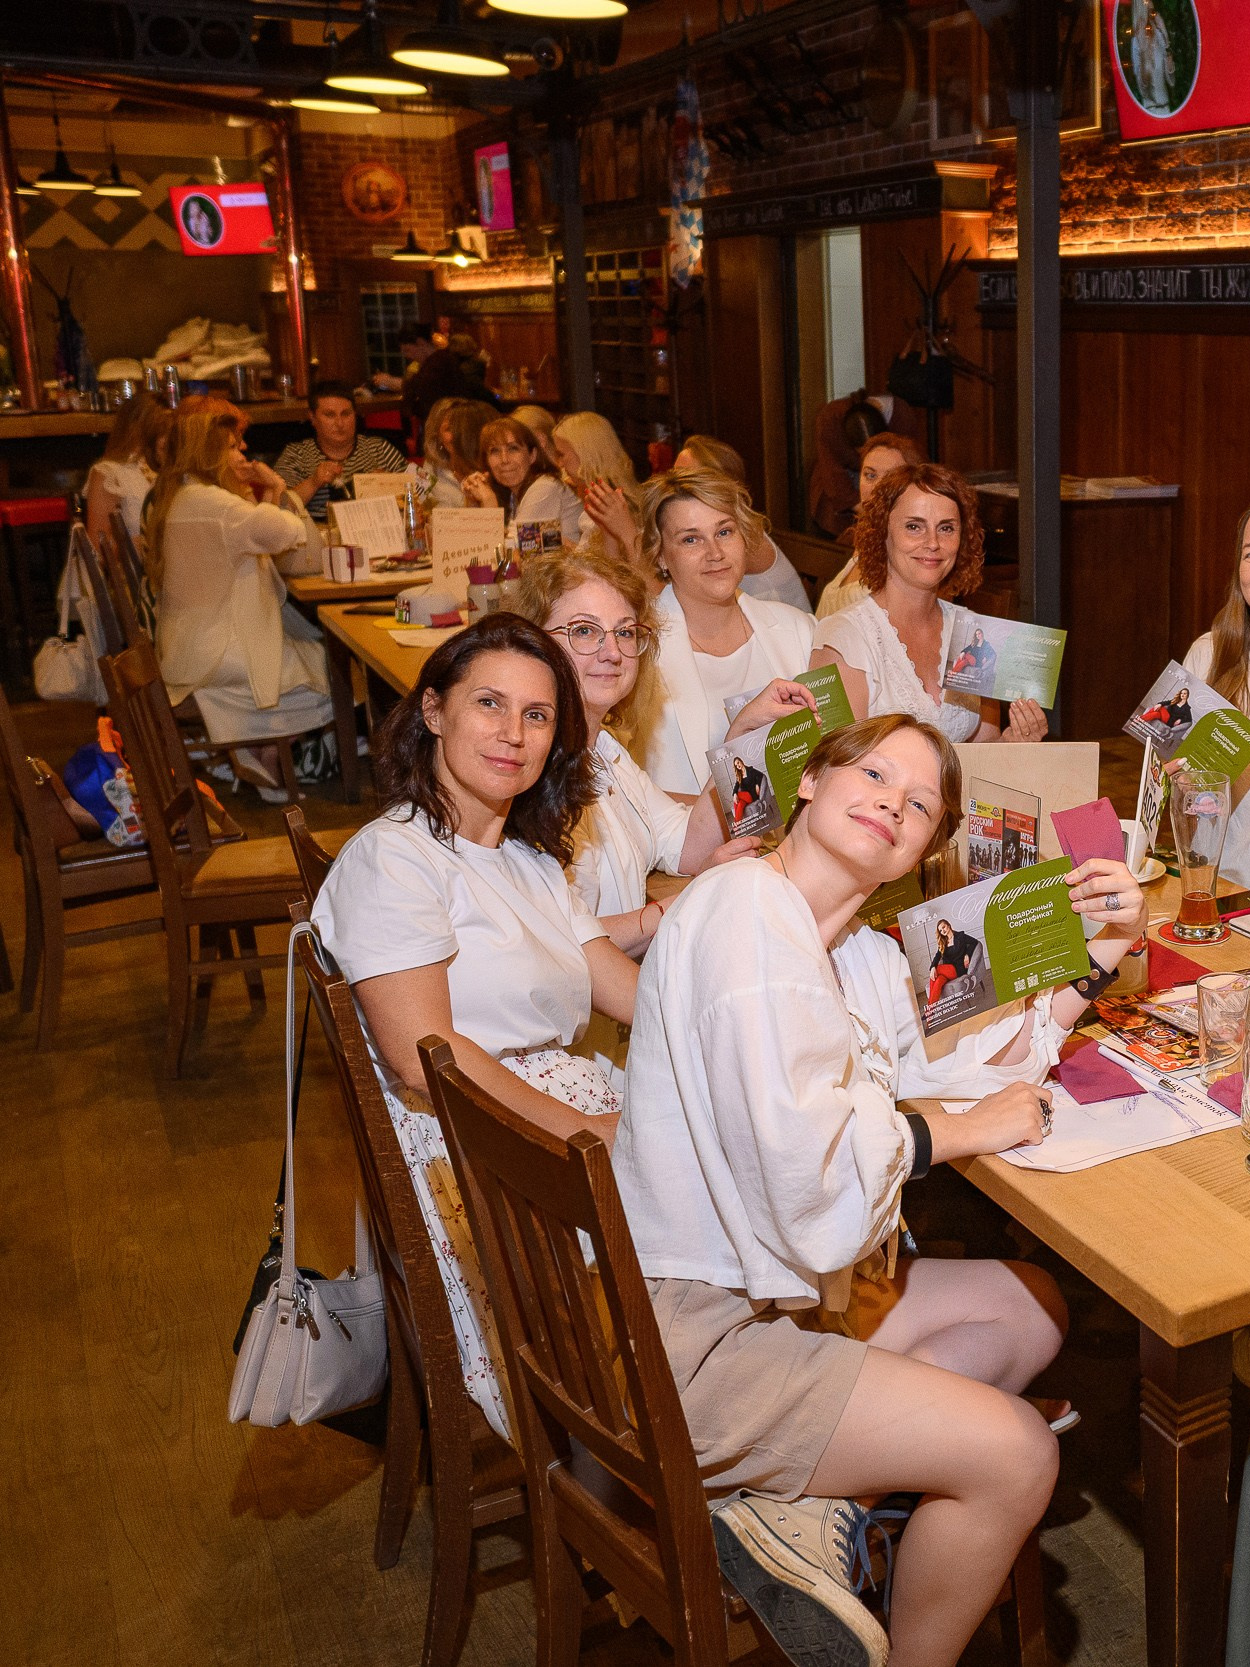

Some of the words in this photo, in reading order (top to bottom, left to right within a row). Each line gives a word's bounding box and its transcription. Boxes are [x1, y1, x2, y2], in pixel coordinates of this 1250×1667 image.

[1200, 269, 1223, 299] ТЫ
[969, 815, 994, 827] РУССКИЙ
[969, 824, 984, 836] РОК
[1006, 901, 1054, 922] Подарочный
[1009, 909, 1054, 928] Сертификат
